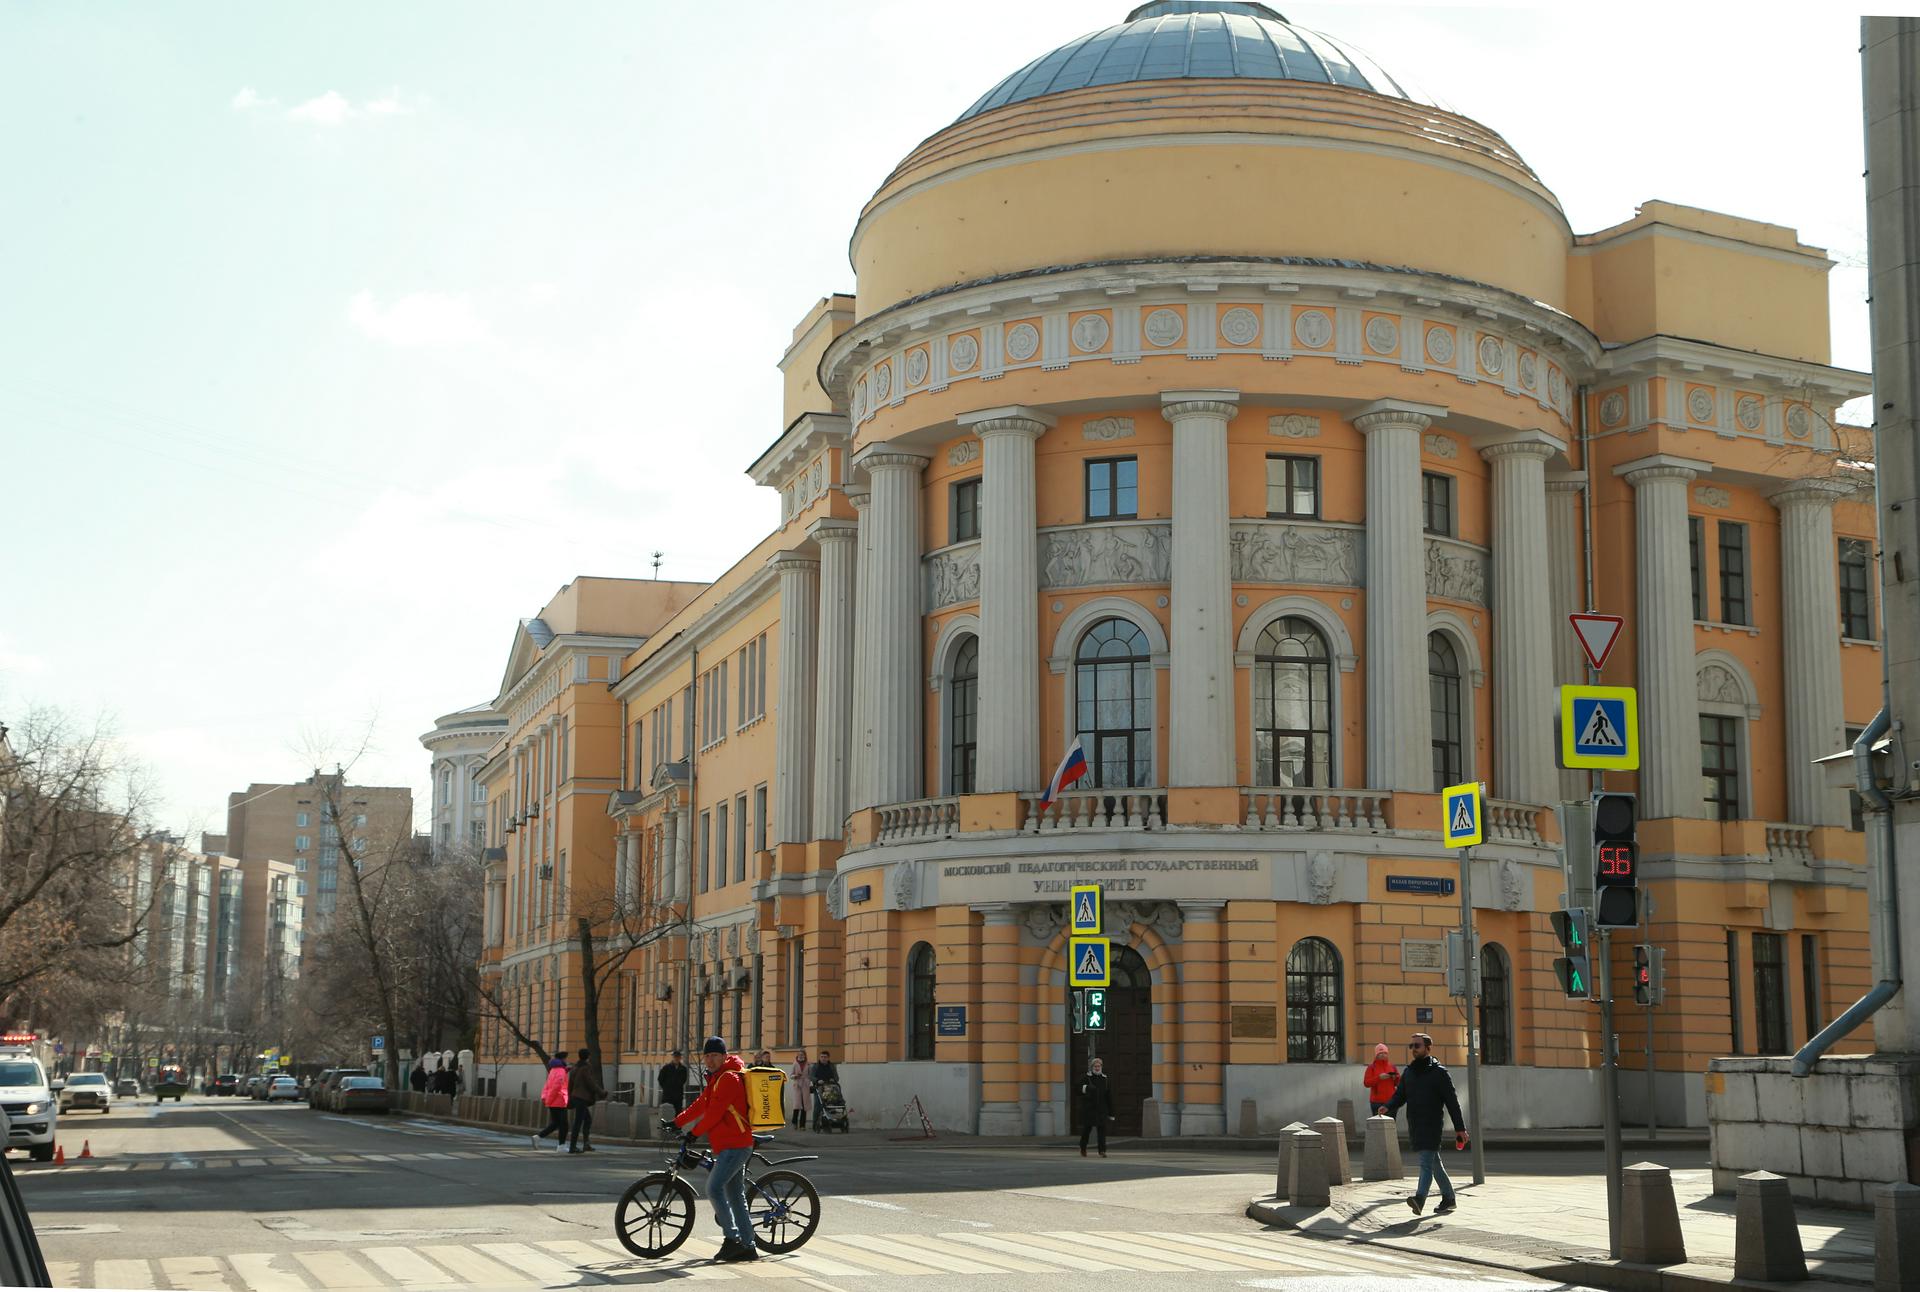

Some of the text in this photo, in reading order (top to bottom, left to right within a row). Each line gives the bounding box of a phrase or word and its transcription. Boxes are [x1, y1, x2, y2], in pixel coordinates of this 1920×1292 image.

[944, 858, 1259, 876] МОСКОВСКИЙ ПЕДАГОГИЧЕСКИЙ ГОСУДАРСТВЕННЫЙ
[1600, 847, 1630, 874] 56
[1091, 993, 1102, 1005] 12
[760, 1080, 770, 1119] Яндекс Еда
